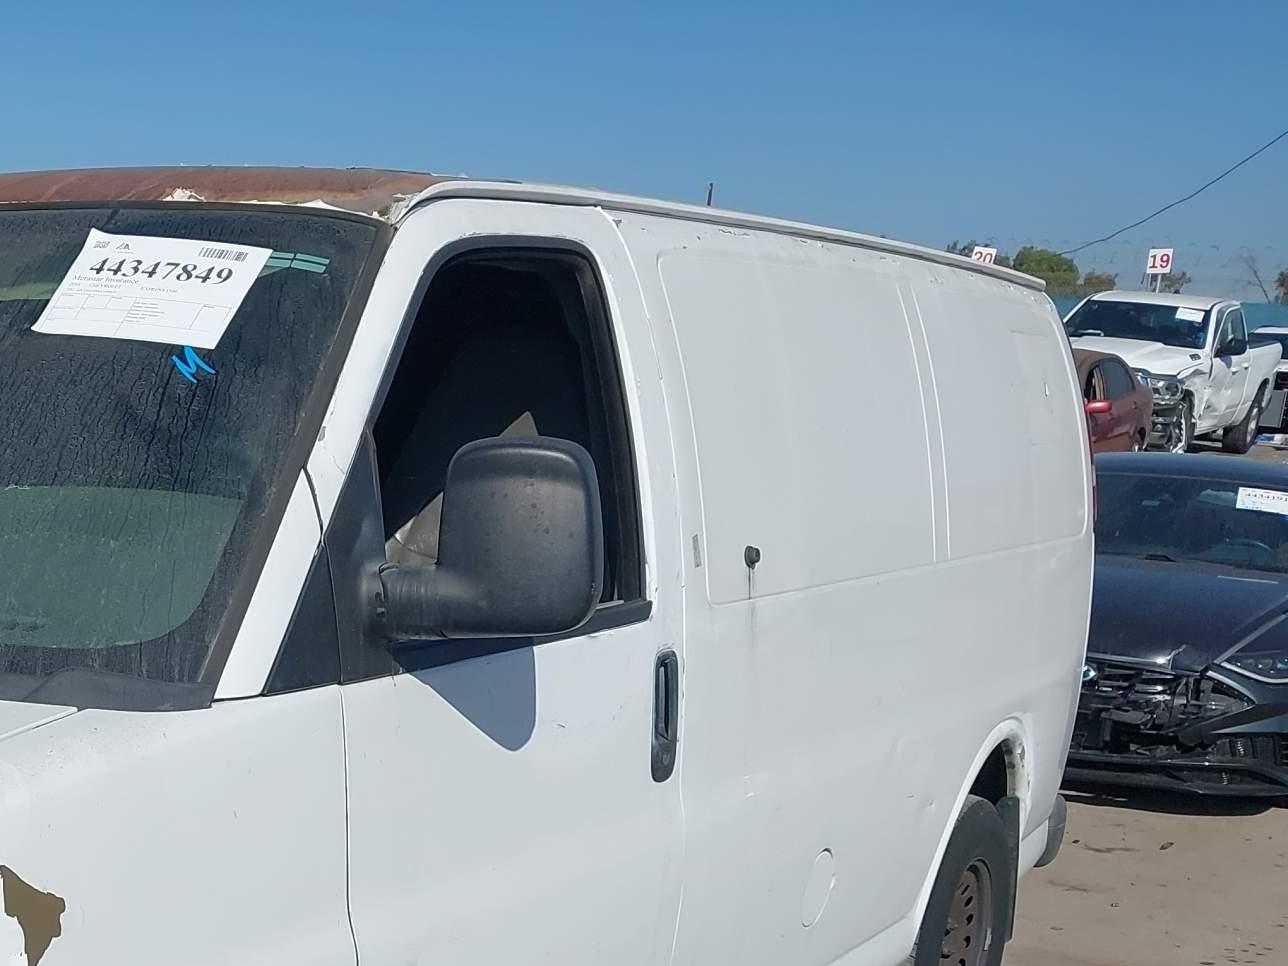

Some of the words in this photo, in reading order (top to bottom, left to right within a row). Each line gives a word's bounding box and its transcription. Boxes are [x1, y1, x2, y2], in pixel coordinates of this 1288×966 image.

[974, 251, 993, 263] 20
[1148, 253, 1170, 269] 19
[89, 257, 234, 285] 44347849
